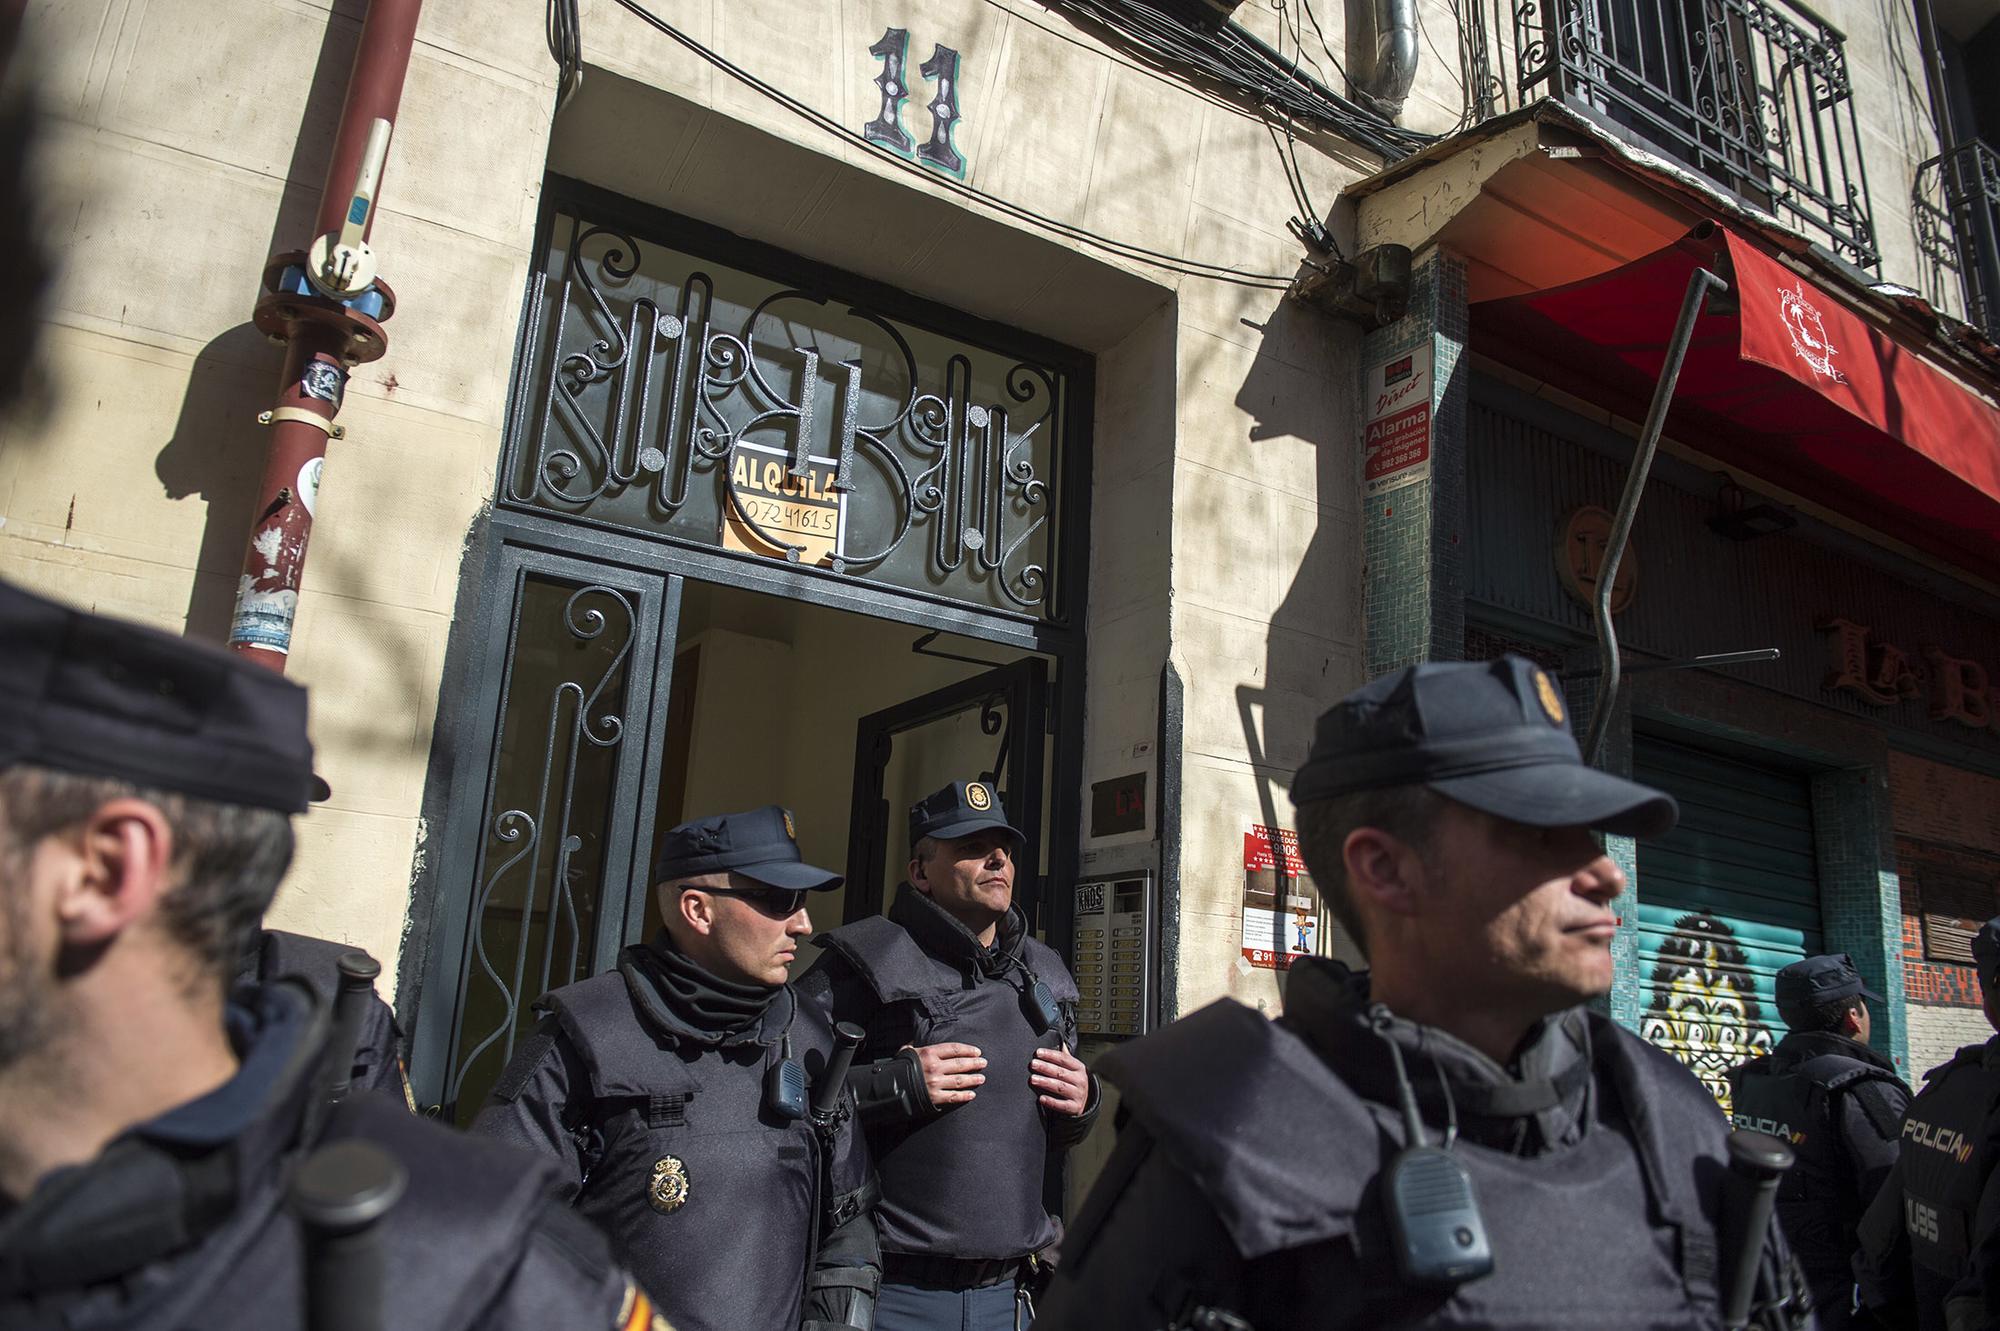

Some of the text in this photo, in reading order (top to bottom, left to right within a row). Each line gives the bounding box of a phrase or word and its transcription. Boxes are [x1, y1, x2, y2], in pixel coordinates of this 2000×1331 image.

[864, 27, 966, 180] 11
[1376, 371, 1424, 415] Direct
[1369, 410, 1426, 442] Alarma
[1381, 434, 1426, 457] de imágenes
[1376, 471, 1408, 488] verisure
[744, 498, 835, 531] 07241615
[1257, 832, 1298, 845] PLATO DE DUC
[1274, 844, 1298, 857] 990€
[1263, 952, 1272, 962] 91
[1733, 1113, 1791, 1141] POLICIA
[1901, 1117, 1963, 1160] POLICIA
